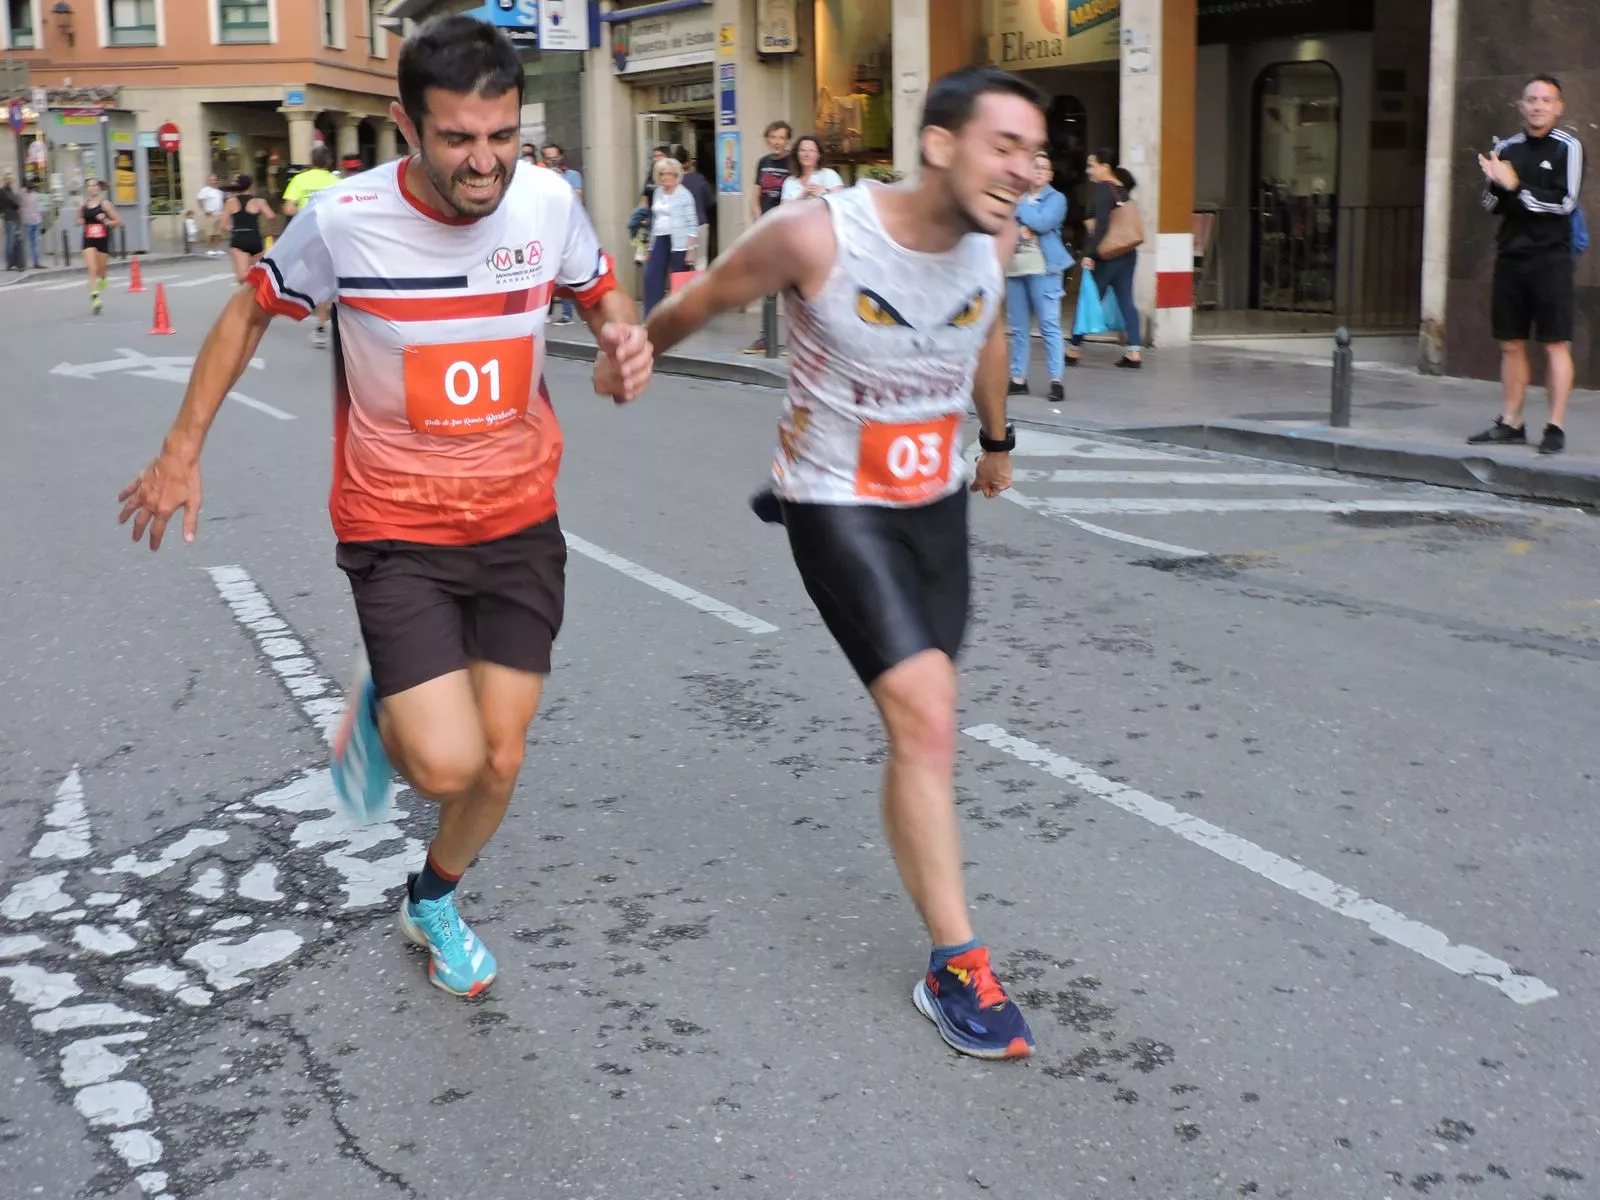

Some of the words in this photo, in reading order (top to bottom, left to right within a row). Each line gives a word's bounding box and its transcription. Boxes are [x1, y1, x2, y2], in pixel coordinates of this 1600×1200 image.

[1000, 31, 1063, 62] Elena
[444, 359, 500, 406] 01
[886, 432, 943, 481] 03
